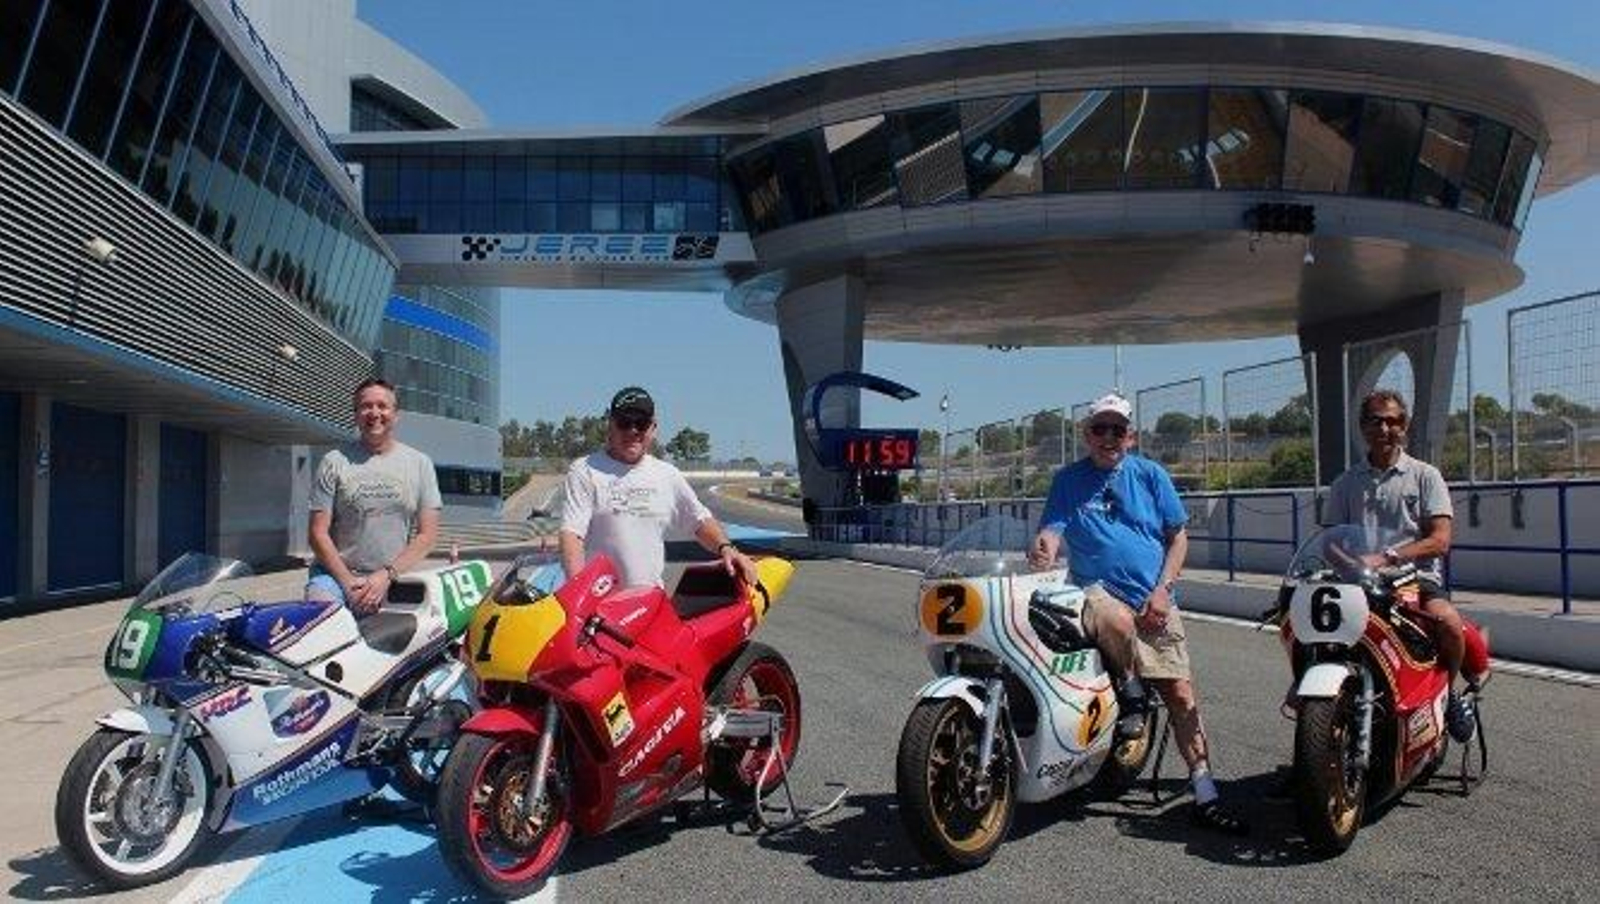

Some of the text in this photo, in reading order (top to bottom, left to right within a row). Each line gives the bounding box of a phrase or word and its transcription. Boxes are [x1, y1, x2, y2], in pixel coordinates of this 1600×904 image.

[443, 569, 481, 611] 19
[936, 584, 967, 635] 2
[1311, 586, 1342, 633] 6
[109, 617, 150, 669] 19
[475, 615, 501, 662] 1
[1086, 694, 1101, 747] 2
